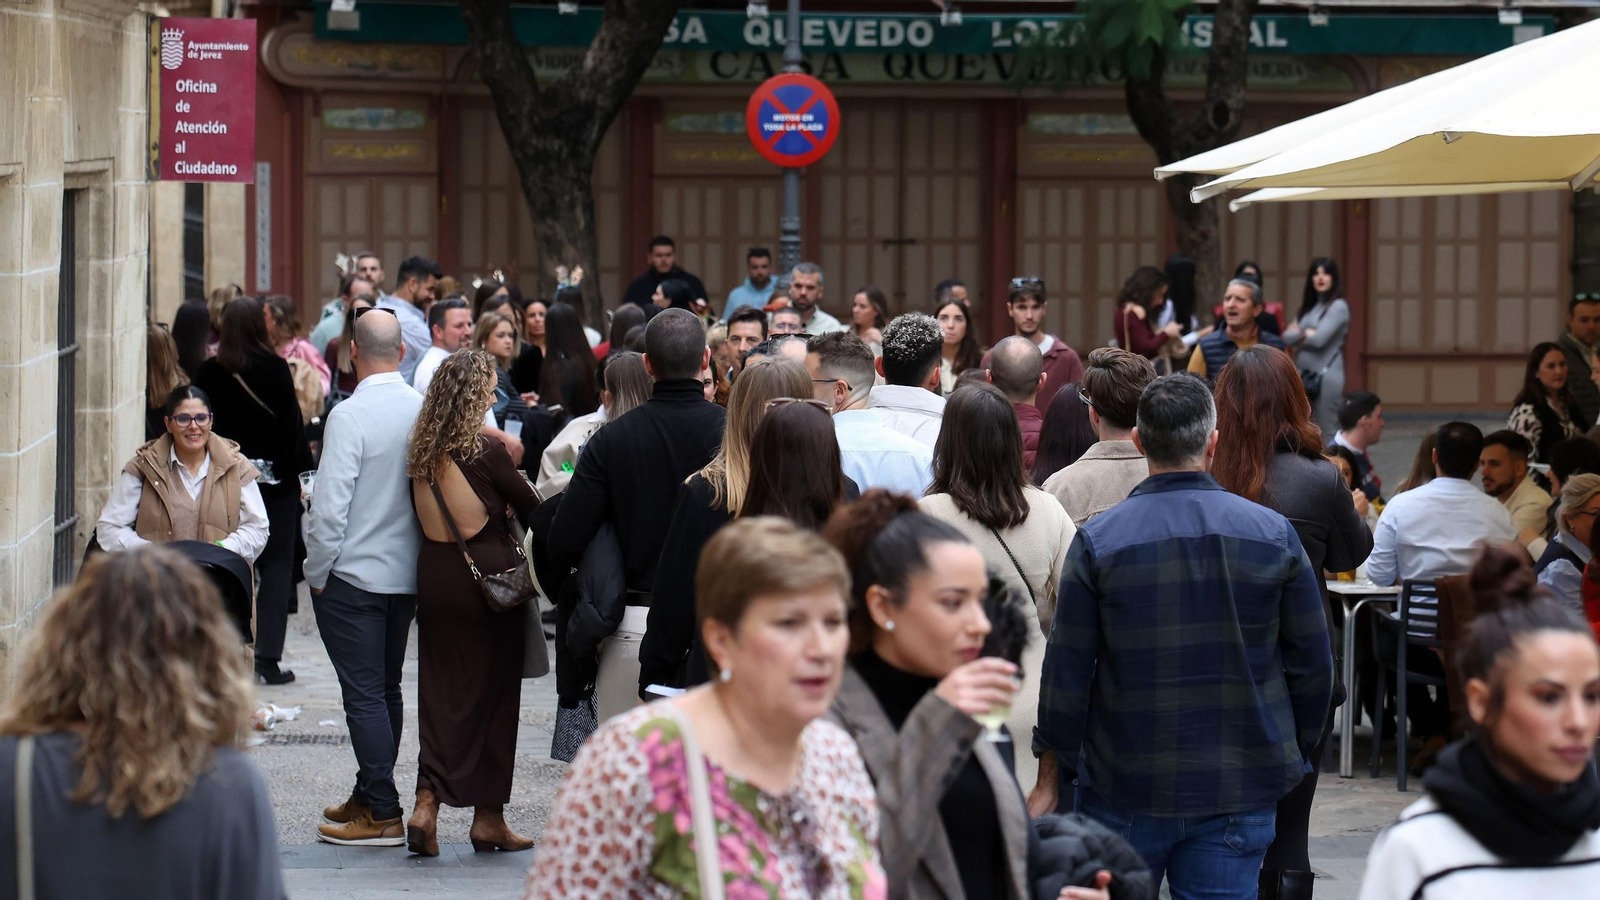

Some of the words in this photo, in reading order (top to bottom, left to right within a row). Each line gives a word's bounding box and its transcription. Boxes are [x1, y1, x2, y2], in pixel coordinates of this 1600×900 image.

[662, 17, 708, 44] SA
[743, 18, 935, 48] QUEVEDO
[1181, 20, 1288, 48] ISAL
[187, 40, 249, 52] Ayuntamiento
[187, 51, 199, 59] de
[200, 51, 222, 60] Jerez
[175, 79, 218, 94] Oficina
[175, 100, 191, 113] de
[773, 113, 801, 122] MOTOS
[174, 121, 227, 135] Atención
[763, 123, 784, 131] TODA
[798, 123, 824, 131] PLAZA
[174, 140, 186, 154] al
[174, 160, 238, 176] Ciudadano
